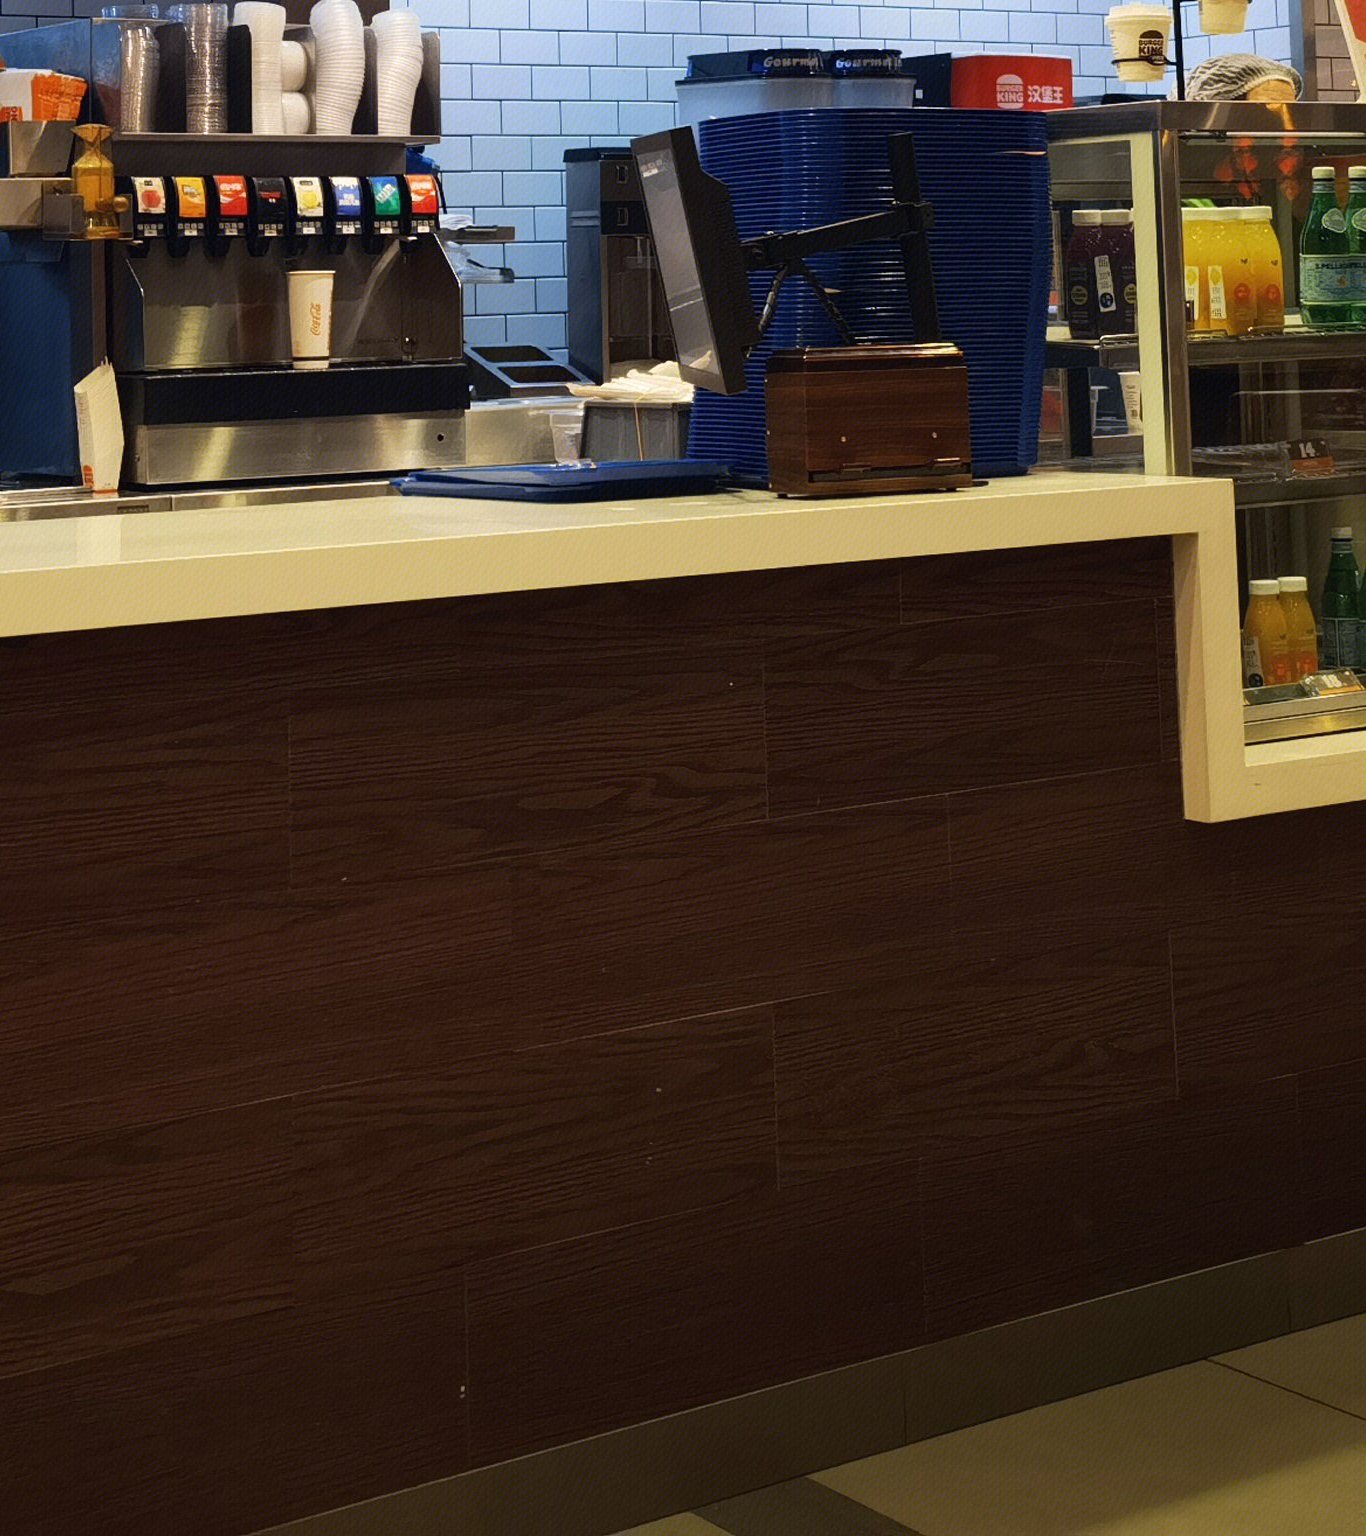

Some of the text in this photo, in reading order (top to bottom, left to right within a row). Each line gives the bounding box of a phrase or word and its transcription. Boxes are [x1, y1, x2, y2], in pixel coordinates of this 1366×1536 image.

[1138, 46, 1164, 56] KING
[996, 91, 1024, 103] KING
[1027, 85, 1064, 104] 汉堡王
[1298, 441, 1315, 458] 14
